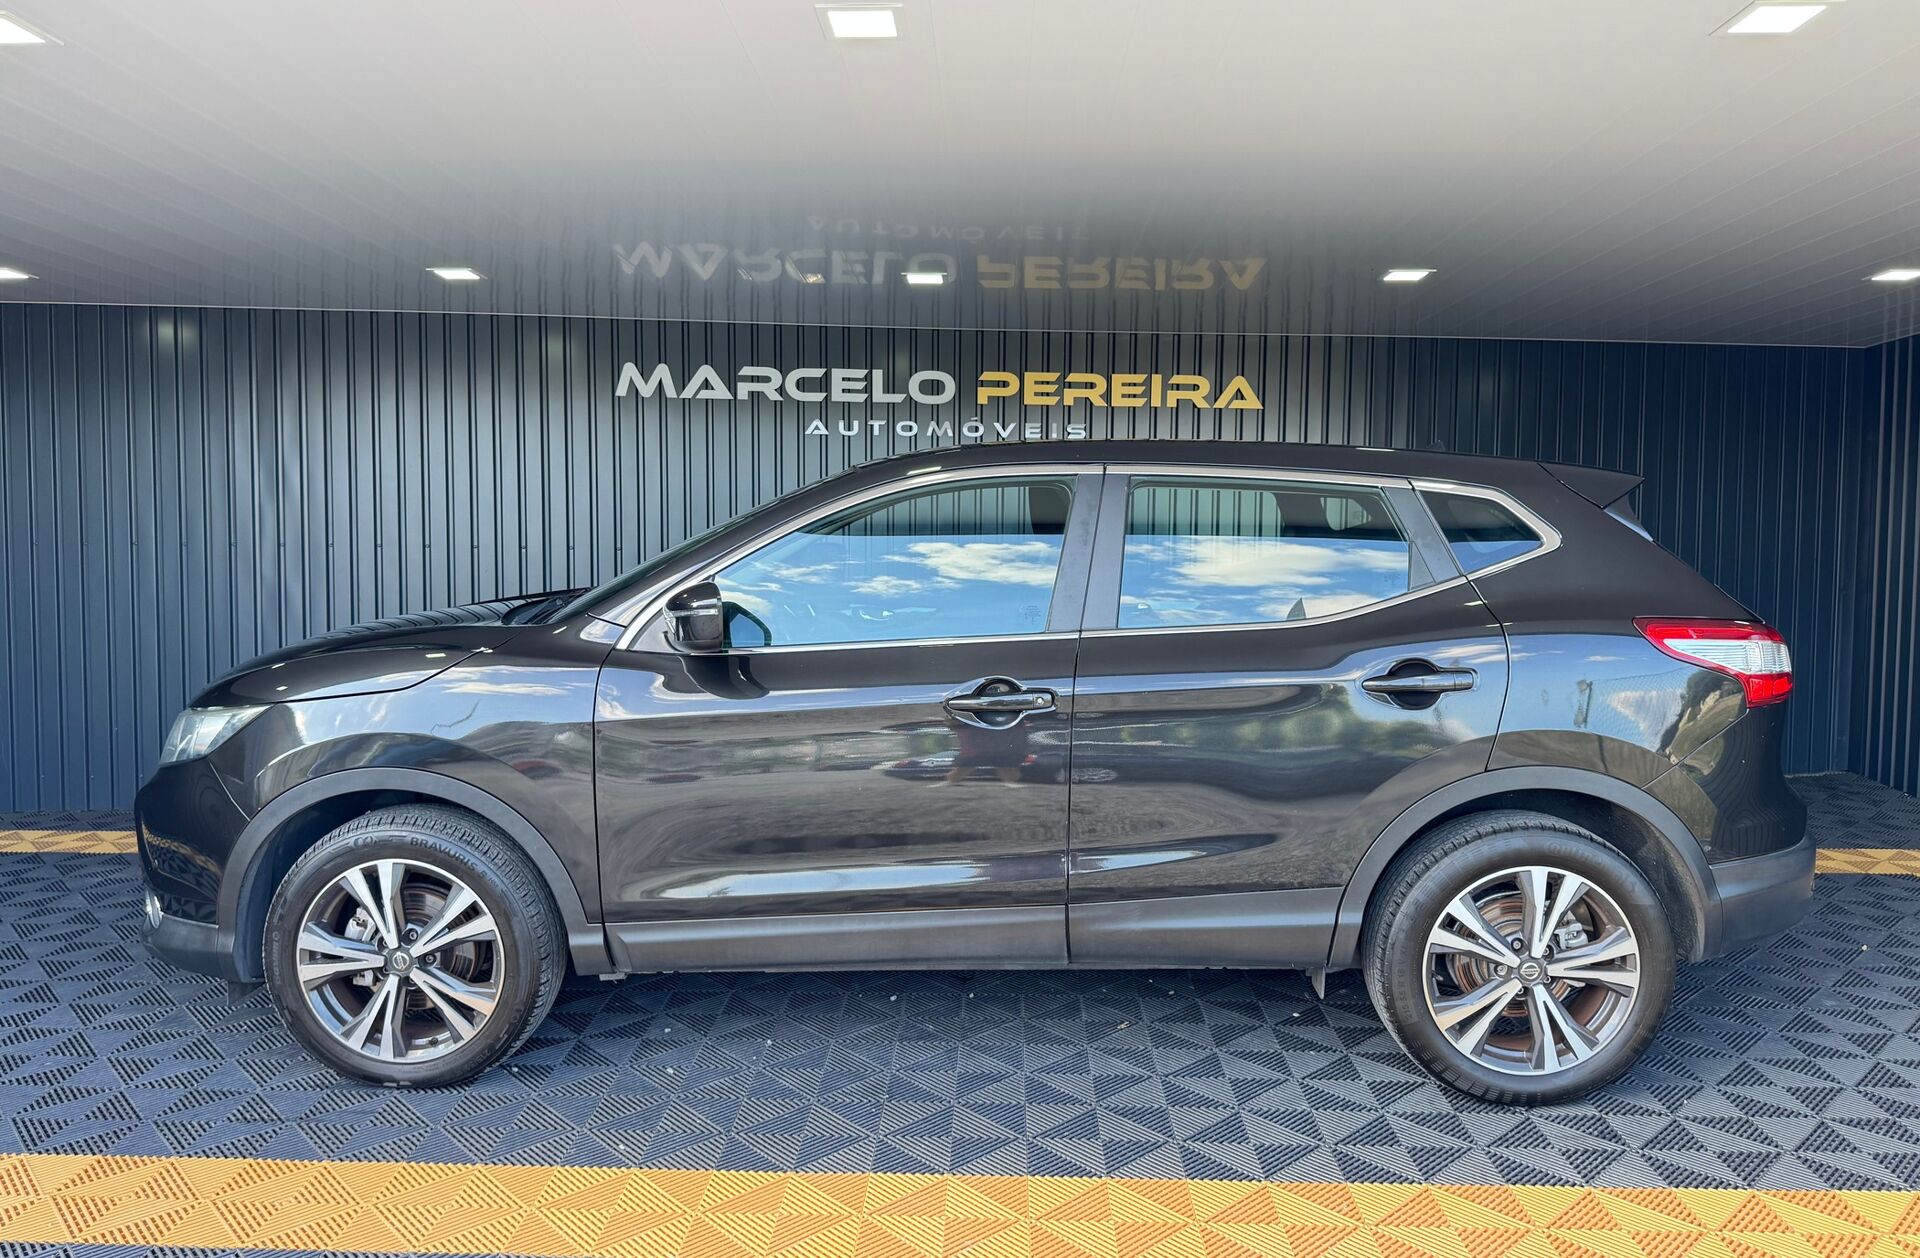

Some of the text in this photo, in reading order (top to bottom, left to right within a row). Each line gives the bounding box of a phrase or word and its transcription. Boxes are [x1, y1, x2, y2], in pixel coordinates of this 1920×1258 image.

[615, 361, 1264, 410] MARCELO PEREIRA
[804, 417, 1087, 440] AUTOMÓVEIS
[409, 836, 478, 872] BRAVURIS
